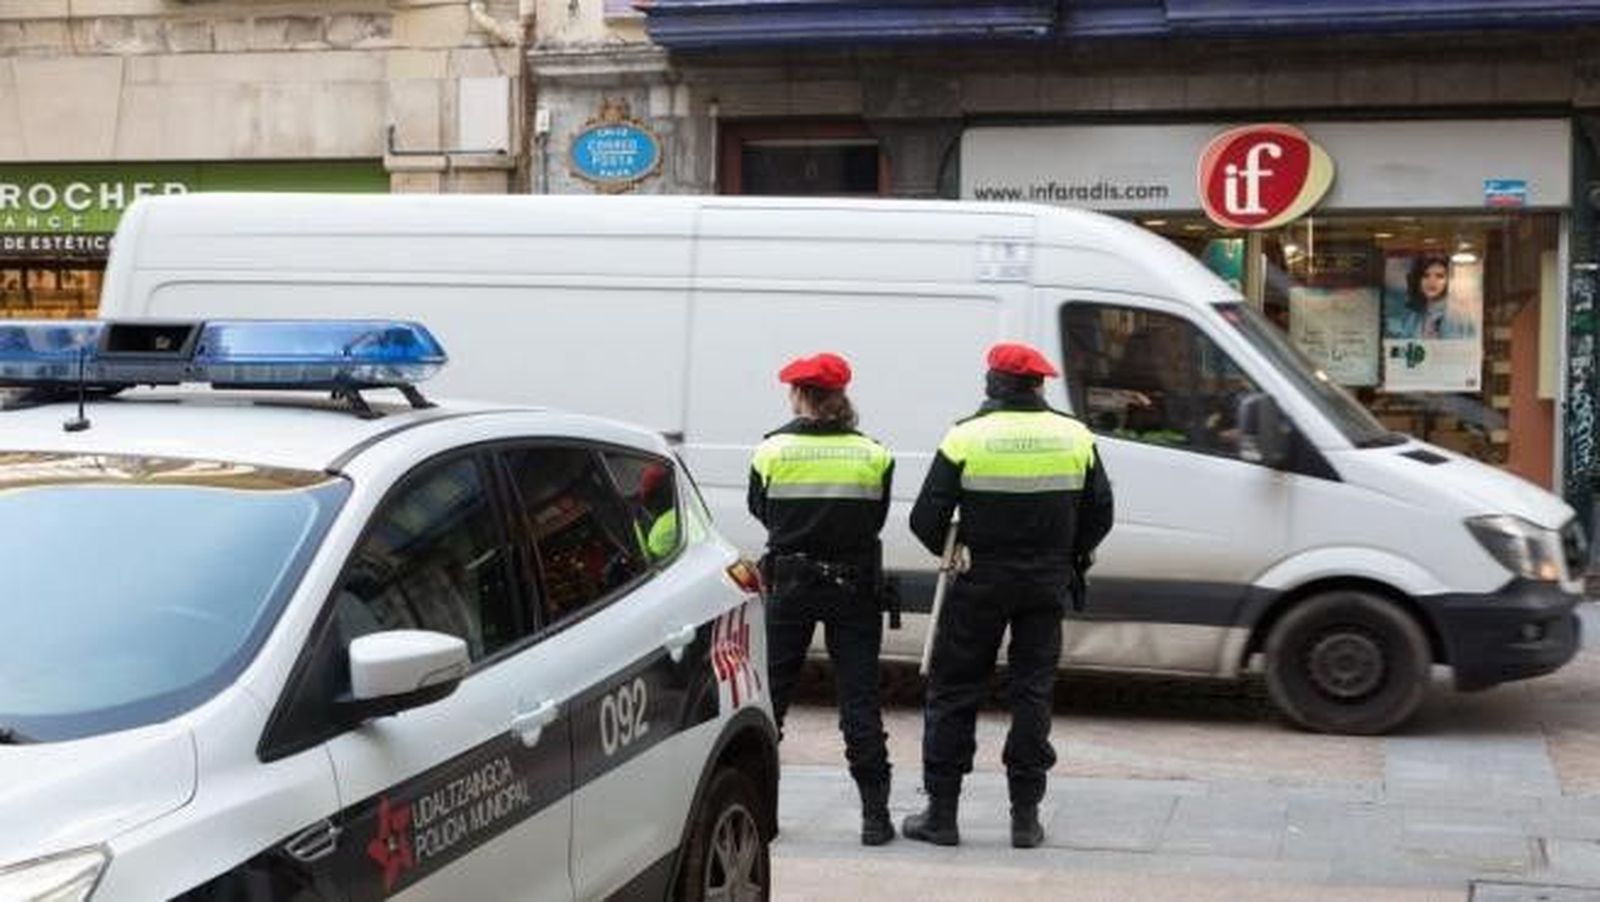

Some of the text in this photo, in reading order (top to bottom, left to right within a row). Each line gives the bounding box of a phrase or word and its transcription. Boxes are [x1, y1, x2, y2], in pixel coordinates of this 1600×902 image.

[974, 182, 1169, 200] www.infaradis.com
[1224, 142, 1282, 215] if
[4, 234, 110, 250] DE ESTÉTIC
[602, 677, 649, 756] 092
